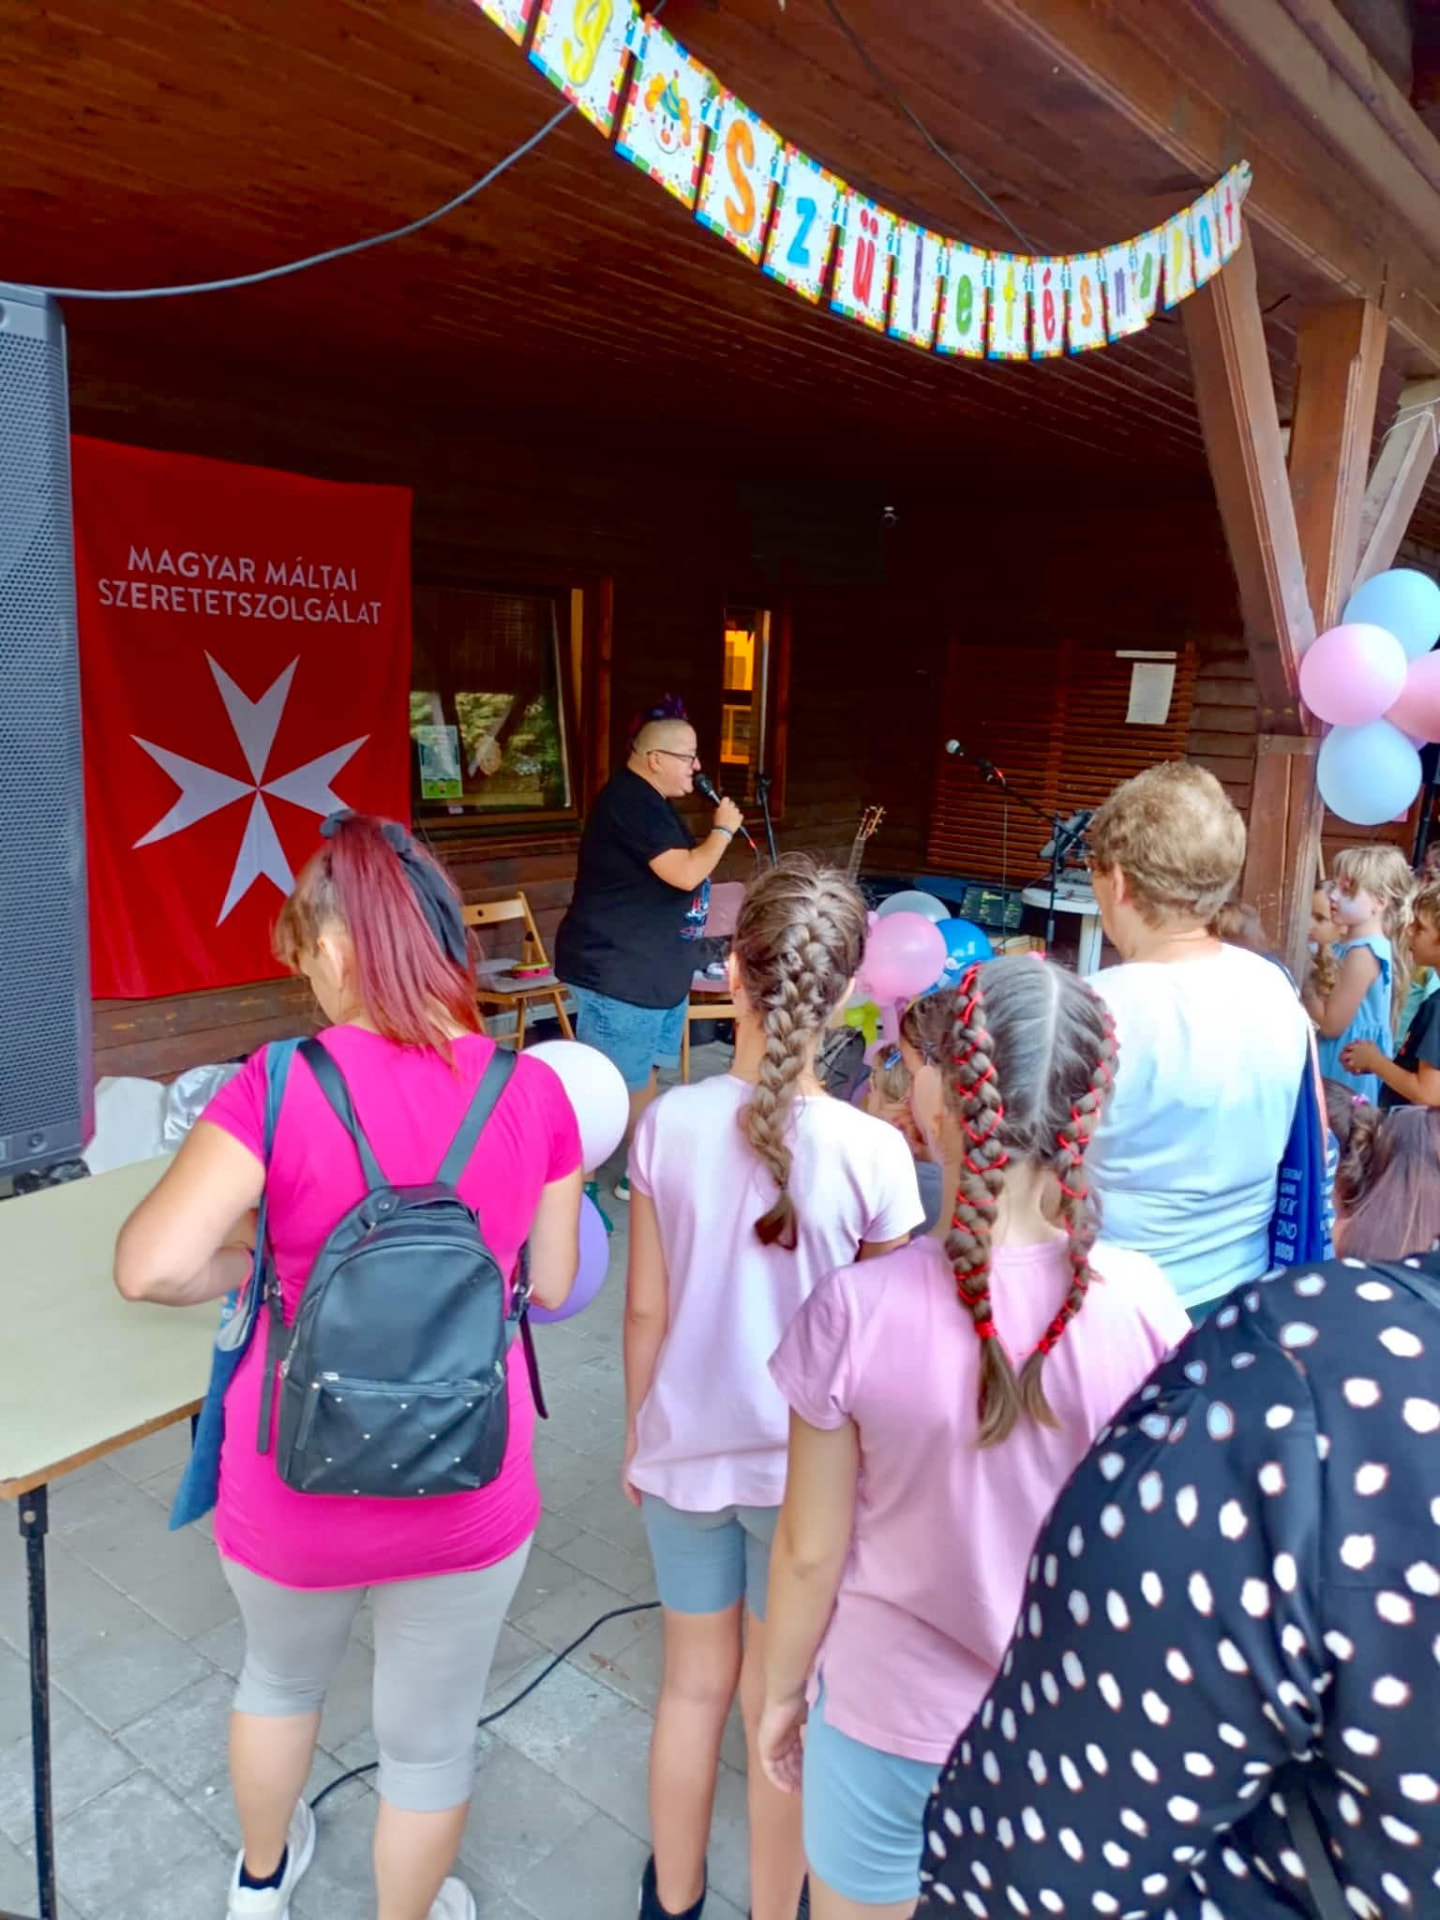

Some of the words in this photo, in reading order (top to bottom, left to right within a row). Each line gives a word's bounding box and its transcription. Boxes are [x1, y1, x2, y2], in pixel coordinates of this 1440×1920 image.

[127, 545, 256, 583] MAGYAR
[264, 556, 358, 591] MÁLTAI
[98, 578, 382, 625] SZERETETSZOLGÁLAT
